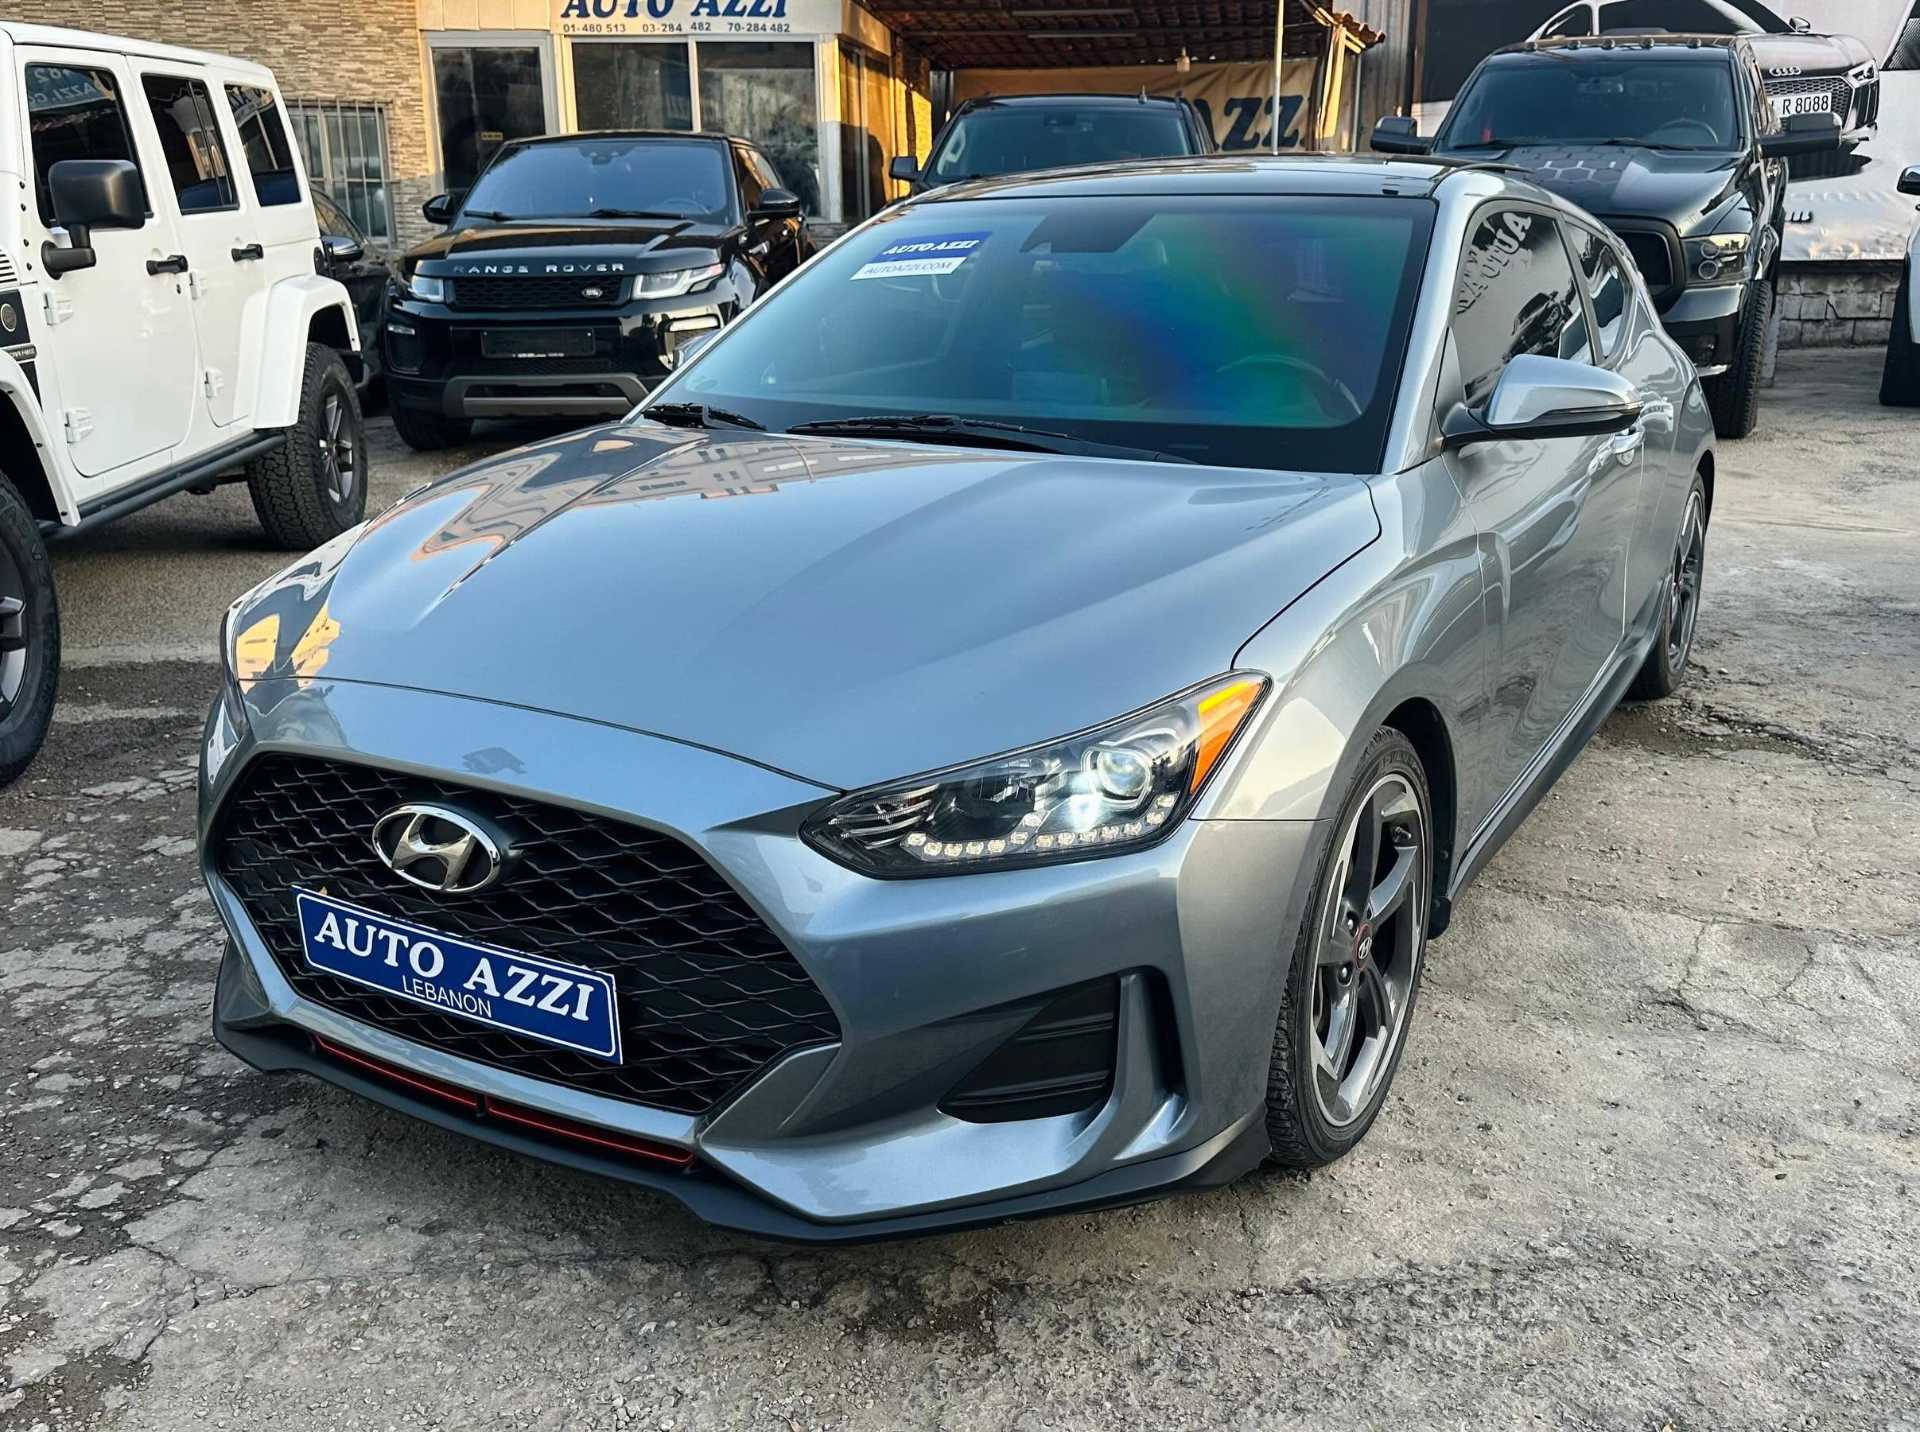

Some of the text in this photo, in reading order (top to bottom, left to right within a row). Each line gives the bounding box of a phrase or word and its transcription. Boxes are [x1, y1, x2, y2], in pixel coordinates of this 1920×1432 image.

[560, 0, 787, 18] AUTO AZZI
[606, 23, 626, 33] 513
[690, 22, 712, 31] 482
[770, 23, 790, 33] 482
[453, 263, 624, 274] RANGE ROVER
[314, 912, 594, 1021] AUTO AZZI
[402, 975, 492, 1018] LEBANON
